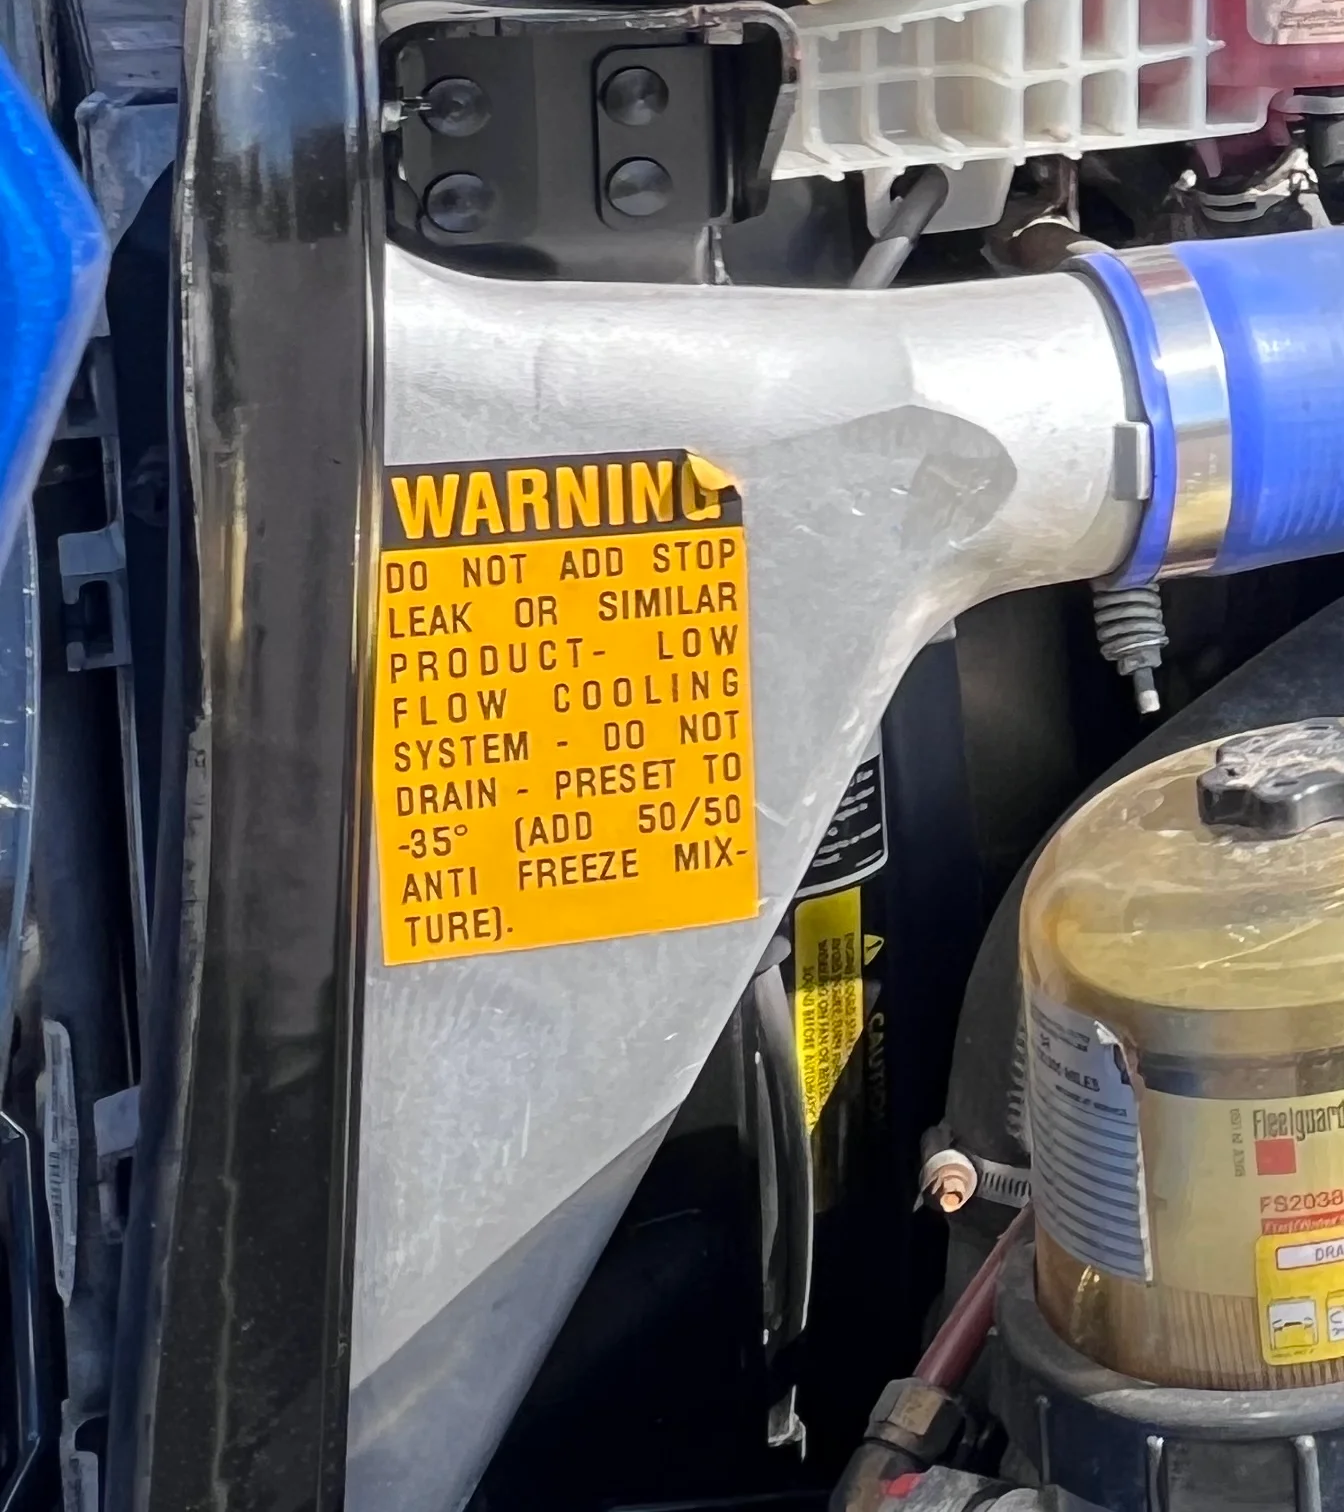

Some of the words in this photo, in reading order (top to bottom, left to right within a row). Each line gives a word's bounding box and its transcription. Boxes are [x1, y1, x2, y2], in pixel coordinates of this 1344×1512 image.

[386, 560, 428, 593] DO
[463, 553, 527, 587] NOT
[559, 547, 623, 581] ADD
[652, 538, 736, 572] STOP
[388, 602, 473, 639] LEAK
[514, 596, 558, 628] OR
[598, 582, 737, 621] SIMILAR
[391, 638, 606, 683] PRODUCT-
[658, 625, 738, 660] LOW
[394, 689, 508, 728] FLOW
[553, 669, 739, 713] COOLING
[394, 731, 528, 772] SYSTEM
[604, 721, 644, 752] DO
[679, 710, 740, 745] NOT
[397, 777, 497, 816] DRAIN
[556, 759, 675, 801] PRESET
[703, 752, 741, 783] TO
[515, 811, 592, 851] (ADD
[638, 795, 741, 834] 50/50
[402, 866, 477, 904] ANTI
[519, 849, 638, 890] FREEZE
[674, 836, 748, 872] MIX-
[405, 906, 513, 946] TURE).
